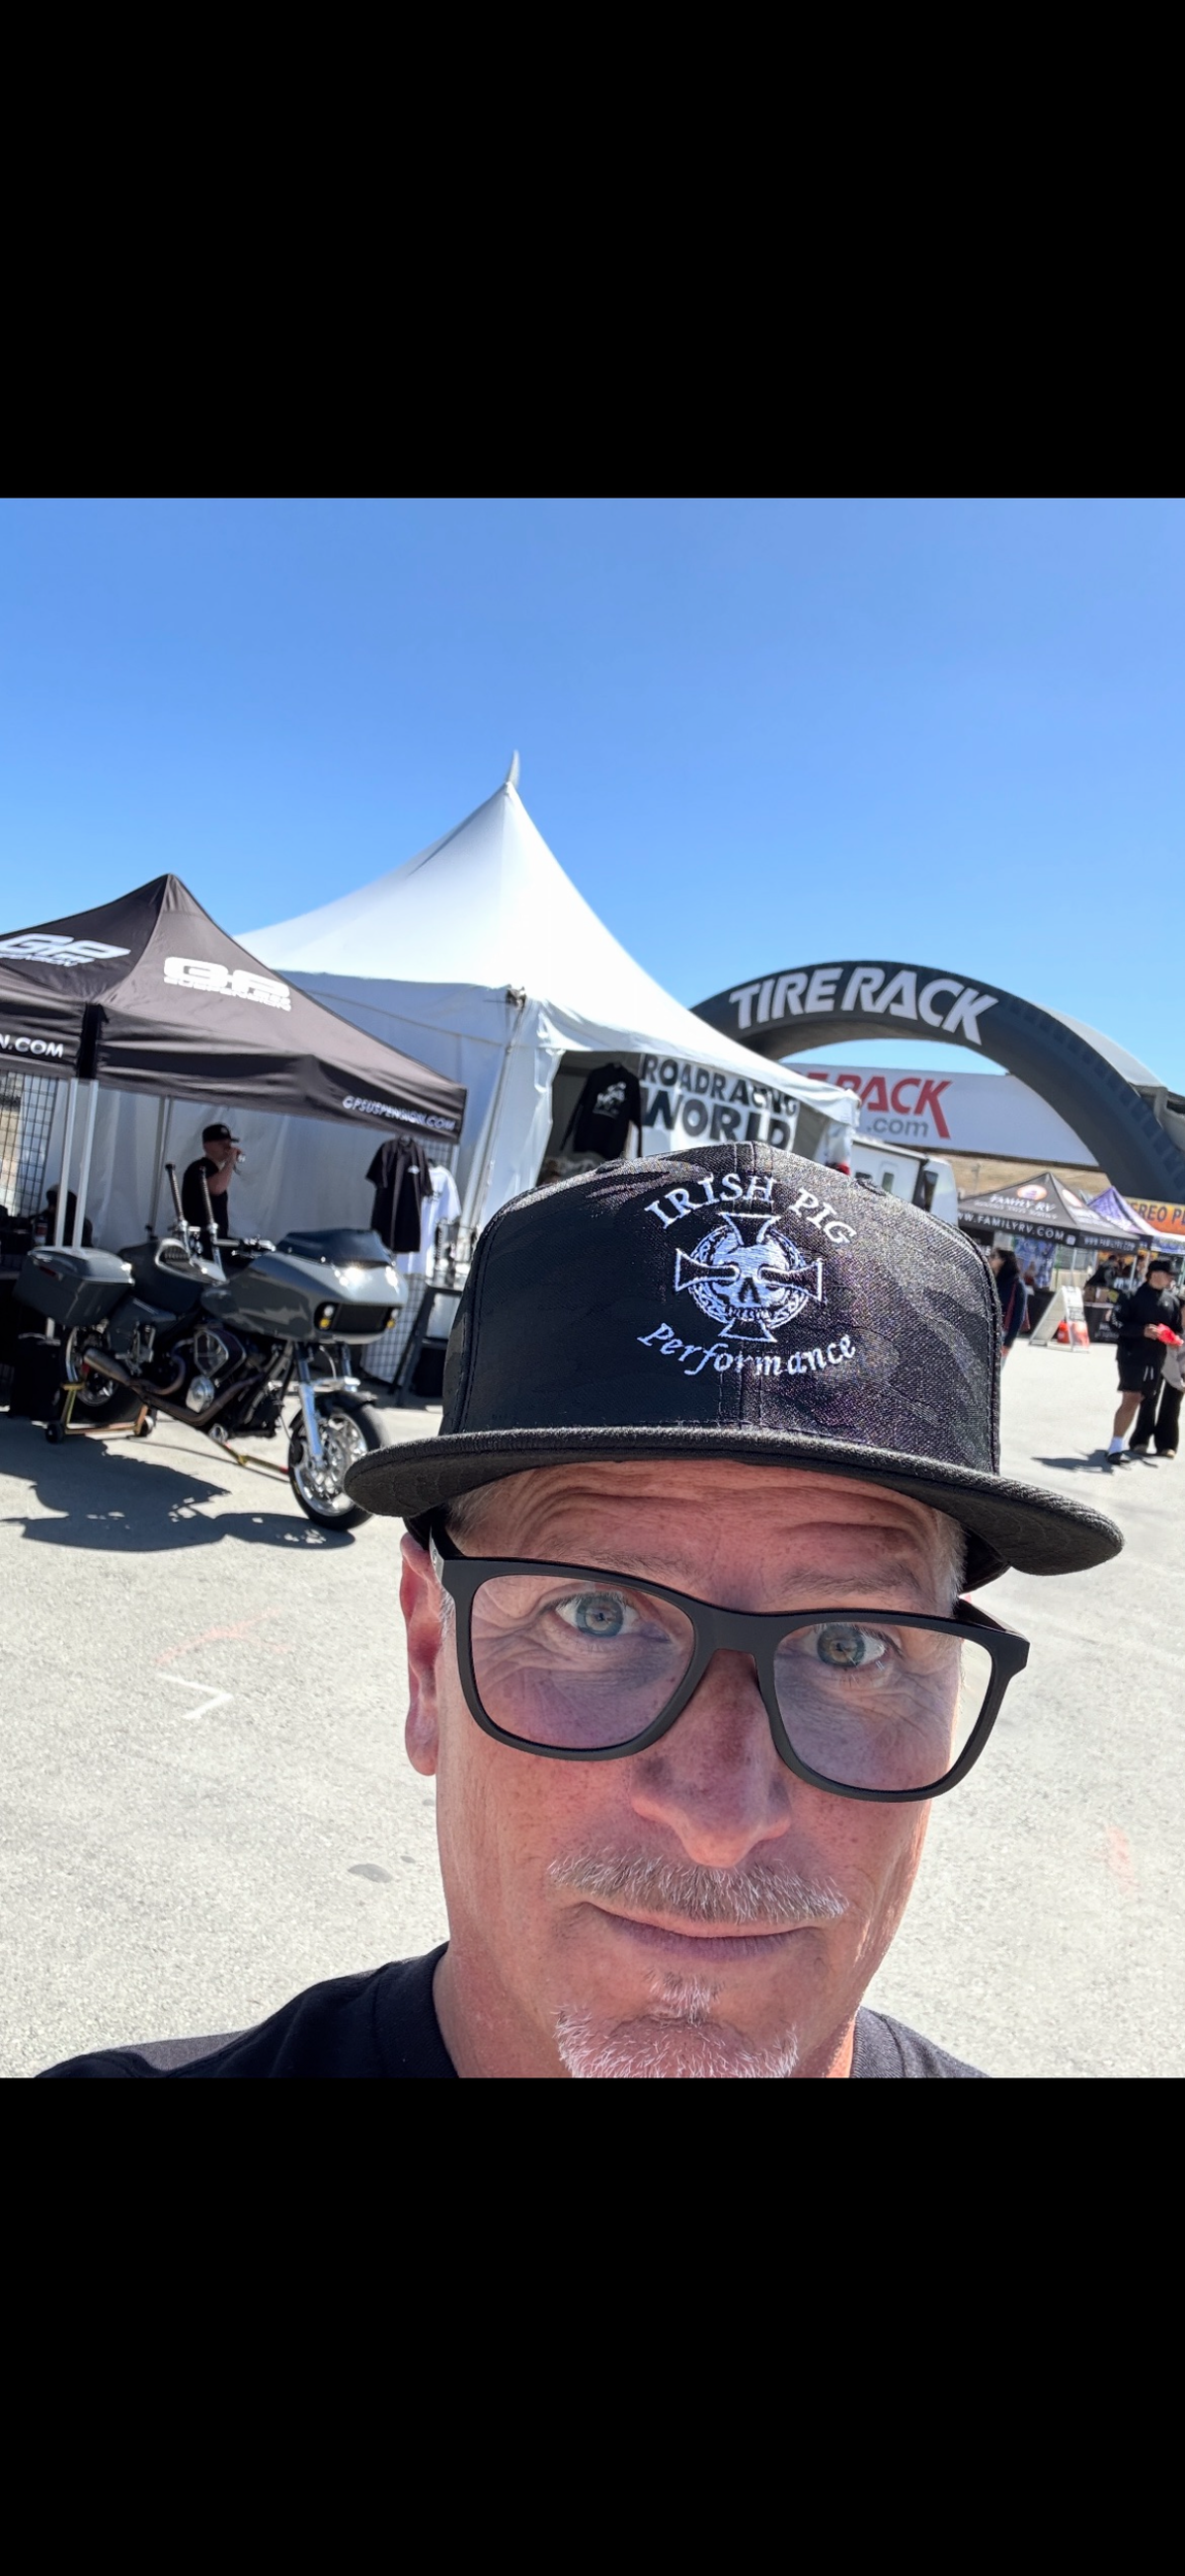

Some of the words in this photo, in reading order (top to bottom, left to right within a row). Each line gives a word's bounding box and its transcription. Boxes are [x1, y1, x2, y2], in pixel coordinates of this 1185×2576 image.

[728, 968, 843, 1030] TIRE
[840, 967, 998, 1046] RACK
[867, 1118, 929, 1136] .com
[644, 1173, 778, 1229] IRISH
[789, 1188, 857, 1244] PIG
[1035, 1201, 1057, 1212] RV
[637, 1322, 856, 1376] Performance
